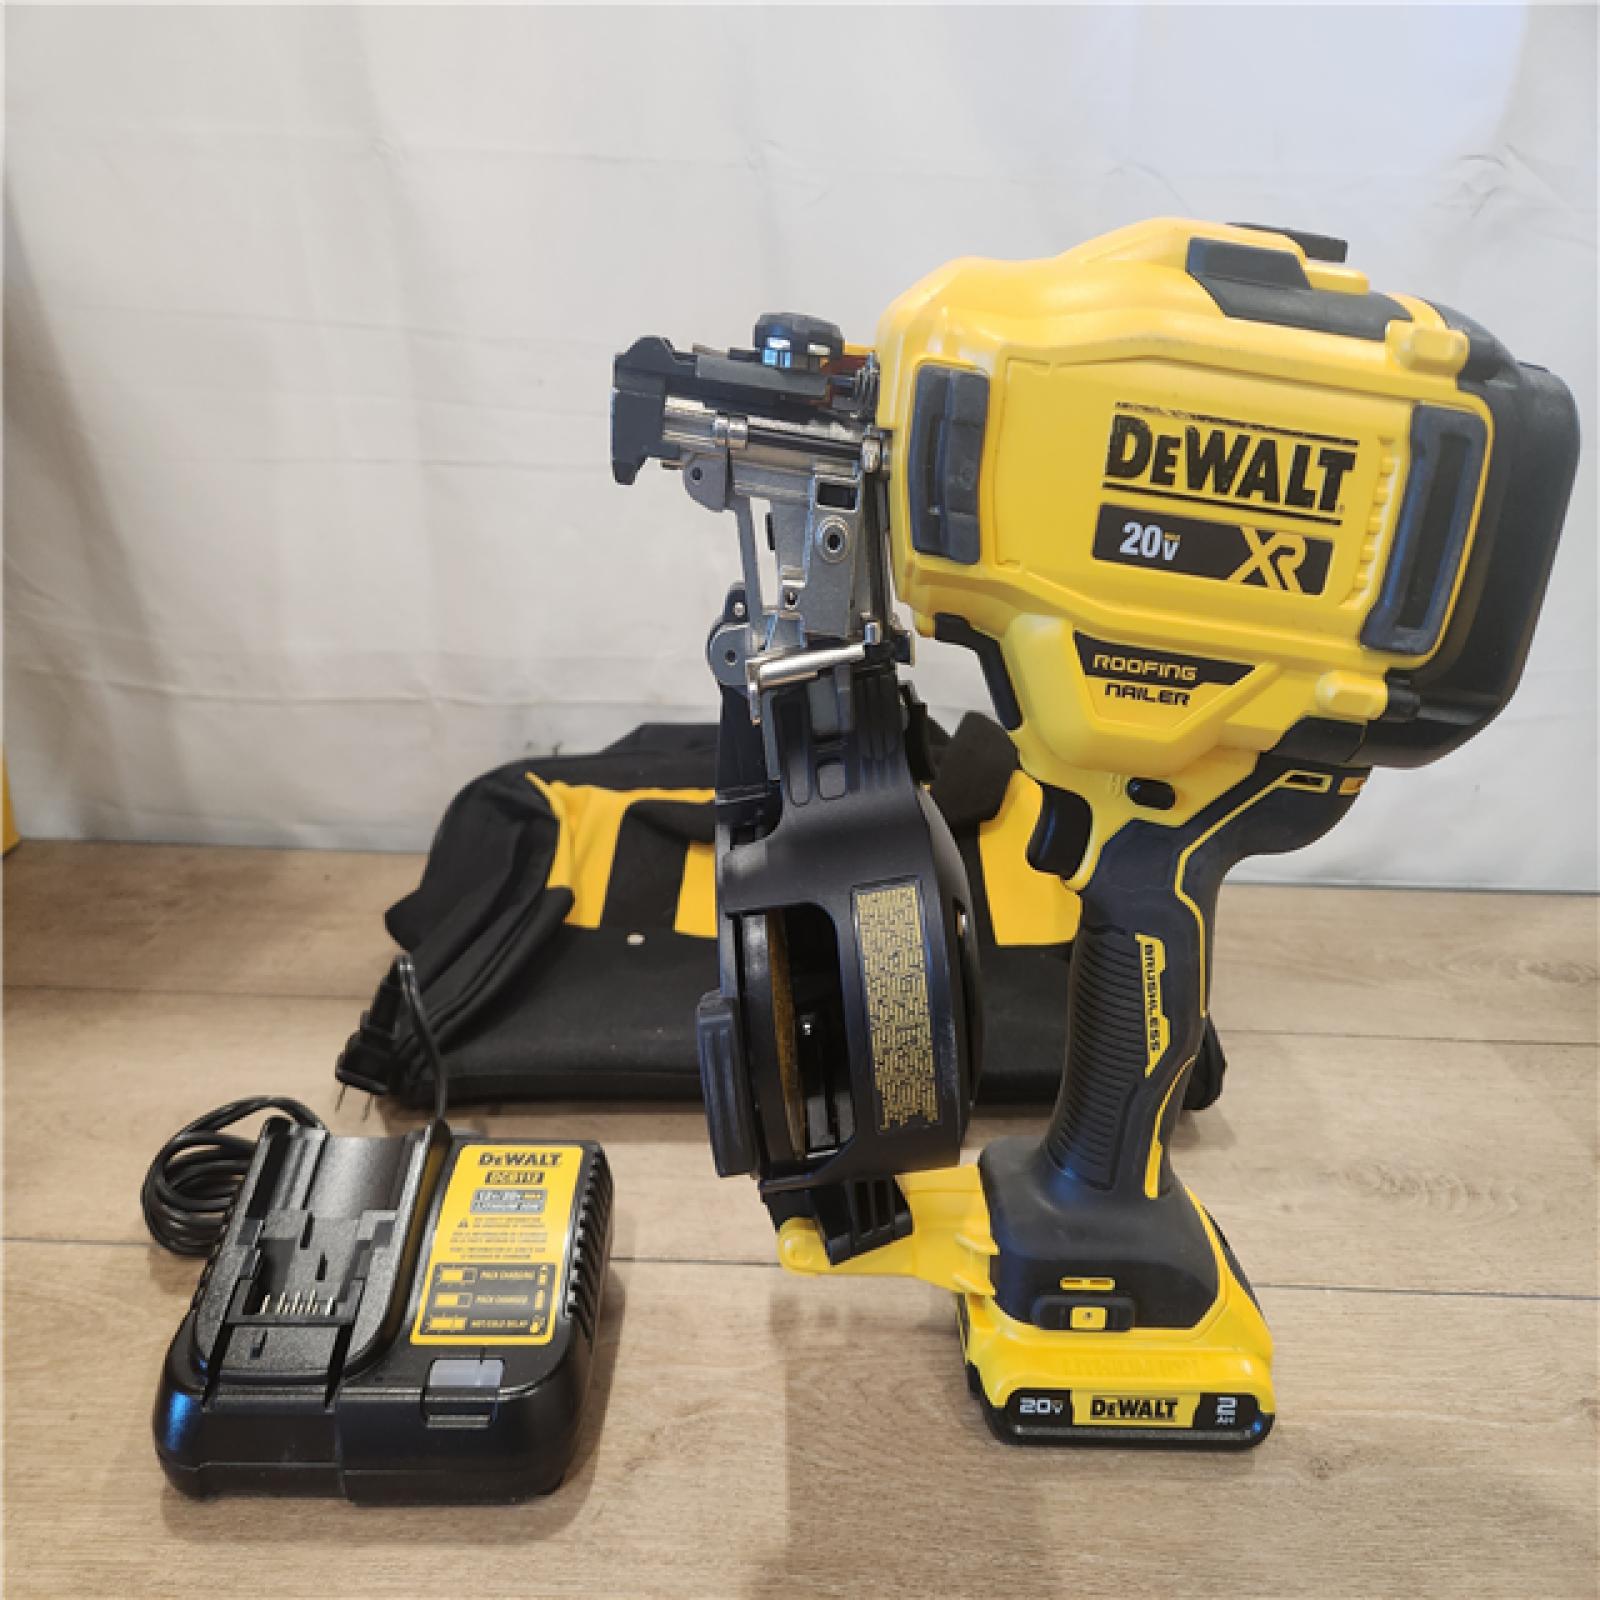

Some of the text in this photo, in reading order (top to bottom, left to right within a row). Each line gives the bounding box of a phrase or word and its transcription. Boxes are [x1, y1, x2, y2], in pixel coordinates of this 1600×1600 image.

[1104, 414, 1356, 513] DEWALT
[1228, 526, 1306, 593] XR
[1092, 654, 1199, 681] ROOFING
[1104, 683, 1191, 706] NAILER
[1144, 943, 1160, 1052] BRUSHLESS
[478, 1152, 562, 1167] DEWALT
[1090, 1398, 1179, 1420] DEWALT
